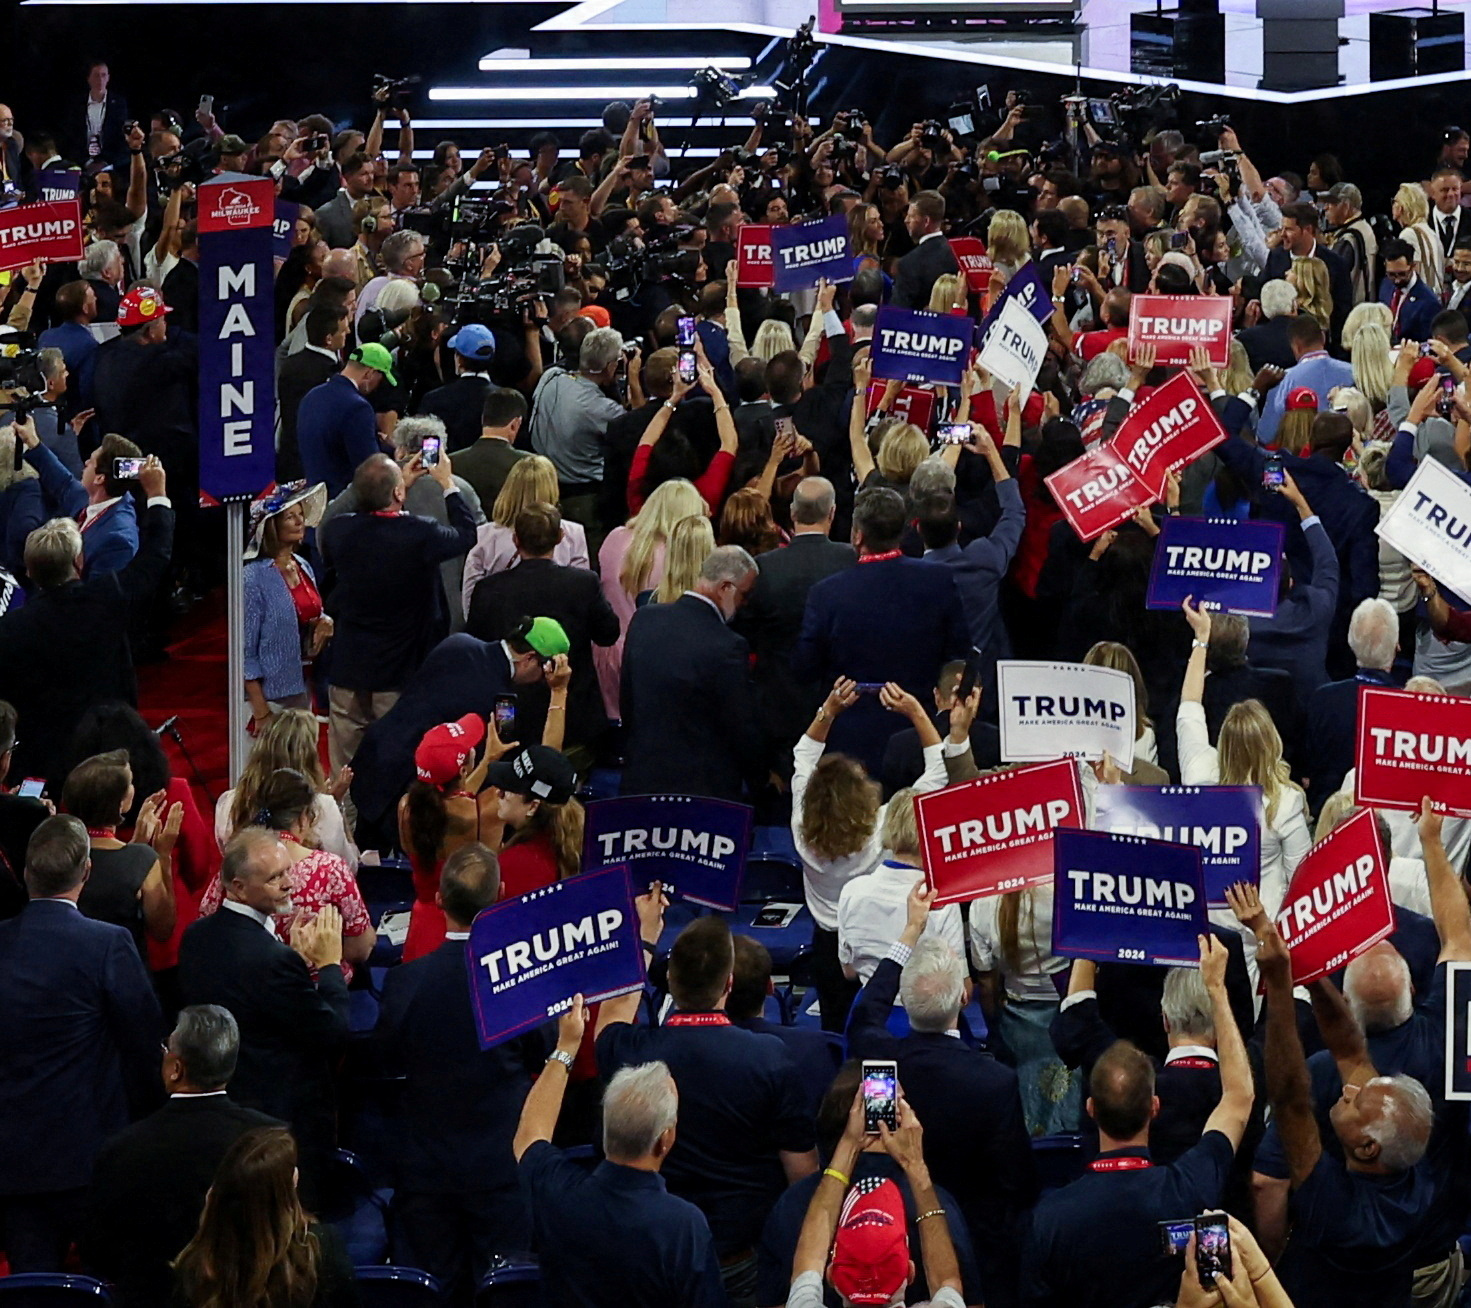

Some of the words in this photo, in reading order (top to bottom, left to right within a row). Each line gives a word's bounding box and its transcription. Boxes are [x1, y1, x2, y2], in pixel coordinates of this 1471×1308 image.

[42, 187, 75, 202] TRUMP
[211, 207, 260, 218] MILWAUKEE
[779, 237, 847, 262] TRUMP
[960, 255, 993, 272] TRUMP
[1139, 317, 1223, 335] TRUMP
[881, 330, 963, 355] TRUMP
[1001, 324, 1039, 373] TRUMP
[219, 265, 255, 457] MAINE
[1128, 398, 1197, 469] TRUMP
[1167, 547, 1271, 575] TRUMP
[1013, 696, 1126, 721] TRUMP
[934, 800, 1070, 854] TRUMP
[597, 827, 735, 860] TRUMP
[602, 855, 627, 865] MAKE
[629, 851, 667, 860] AMERICA
[668, 851, 696, 862] GREAT
[697, 857, 727, 871] AGAIN!
[997, 876, 1025, 890] 2024
[1068, 870, 1194, 911] TRUMP
[1277, 856, 1375, 937] TRUMP
[480, 909, 623, 982] TRUMP
[1118, 949, 1145, 960] 2024
[493, 979, 517, 994] MAKE
[518, 965, 554, 984] AMERICA
[557, 952, 584, 967] GREAT
[588, 941, 619, 955] AGAIN!
[547, 998, 573, 1016] 2024
